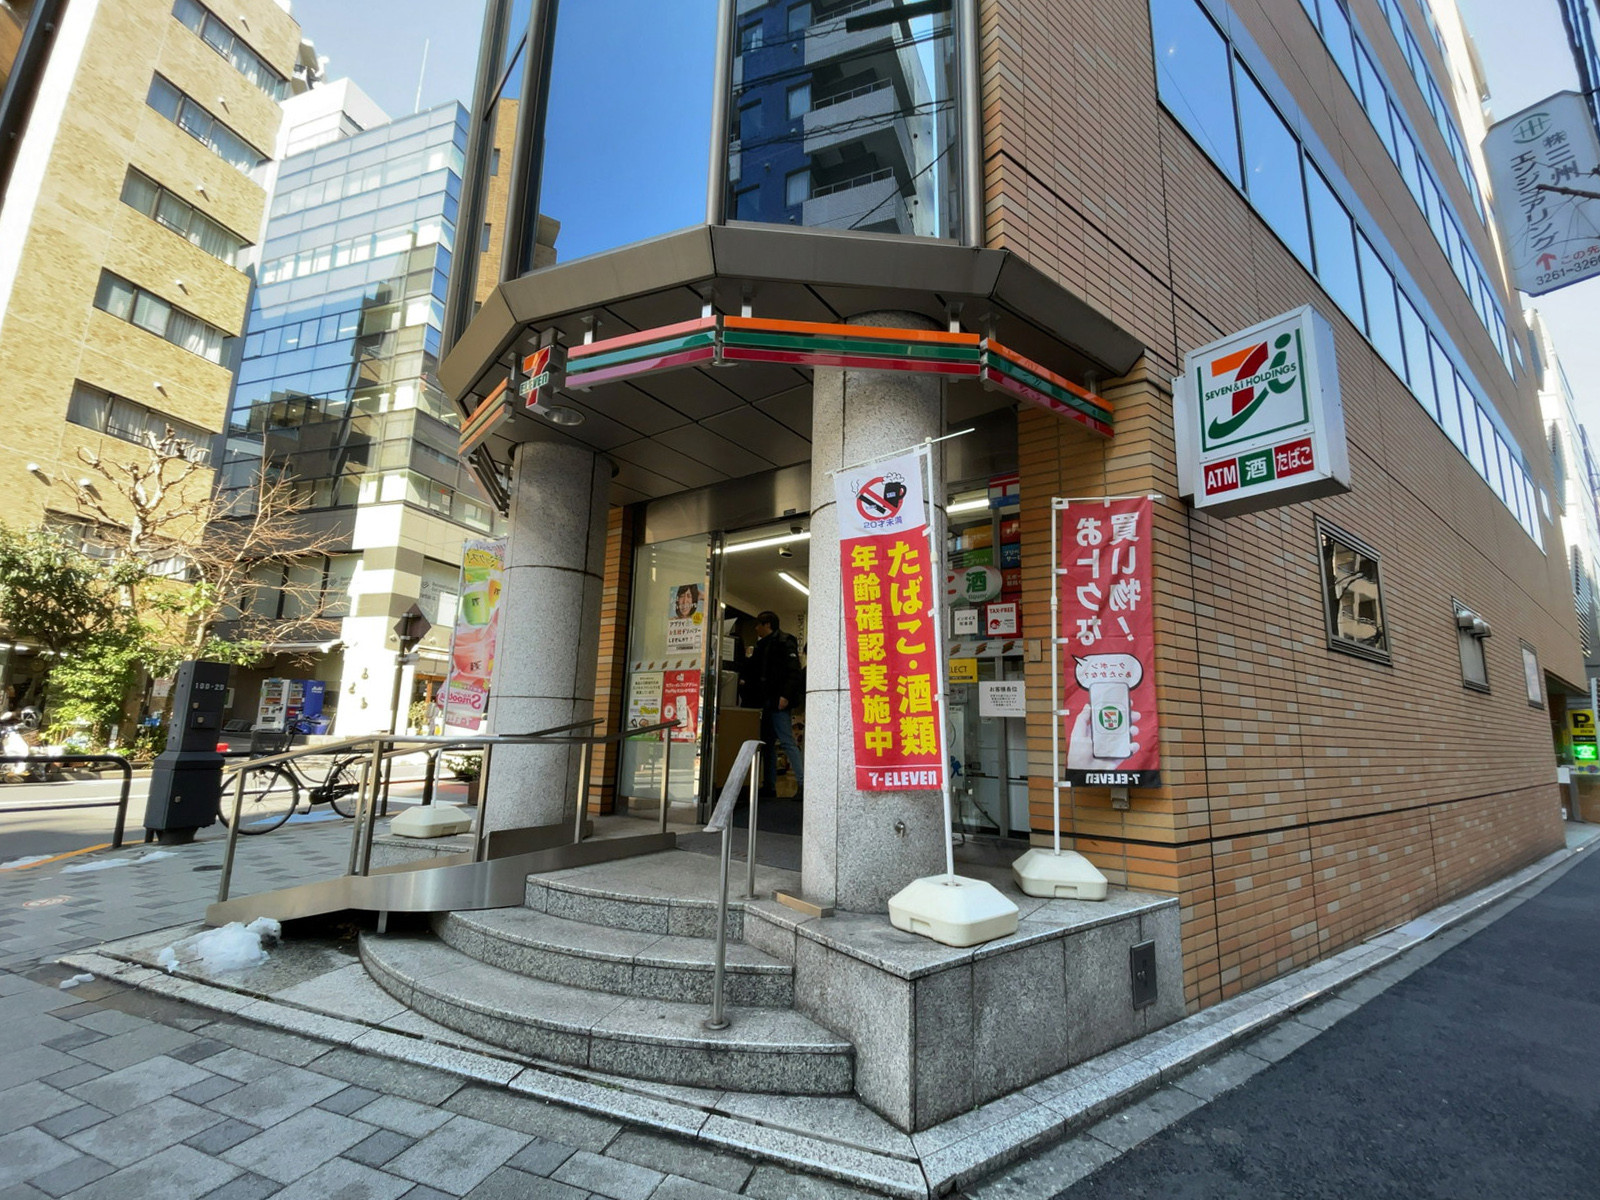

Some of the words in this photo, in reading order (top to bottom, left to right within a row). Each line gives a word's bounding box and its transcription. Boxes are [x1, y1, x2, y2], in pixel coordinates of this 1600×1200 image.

[1510, 149, 1559, 252] エンジニアリング
[1246, 362, 1297, 387] HOLDINGS
[1207, 464, 1237, 489] ATM
[1245, 457, 1267, 480] 酒
[1276, 446, 1313, 472] たばこ
[863, 515, 903, 529] 20才未満
[965, 571, 987, 593] 酒
[851, 545, 893, 757] 年齢確認実施中
[888, 541, 937, 756] たばこ・酒類
[949, 665, 967, 673] LECT
[1573, 713, 1590, 728] P
